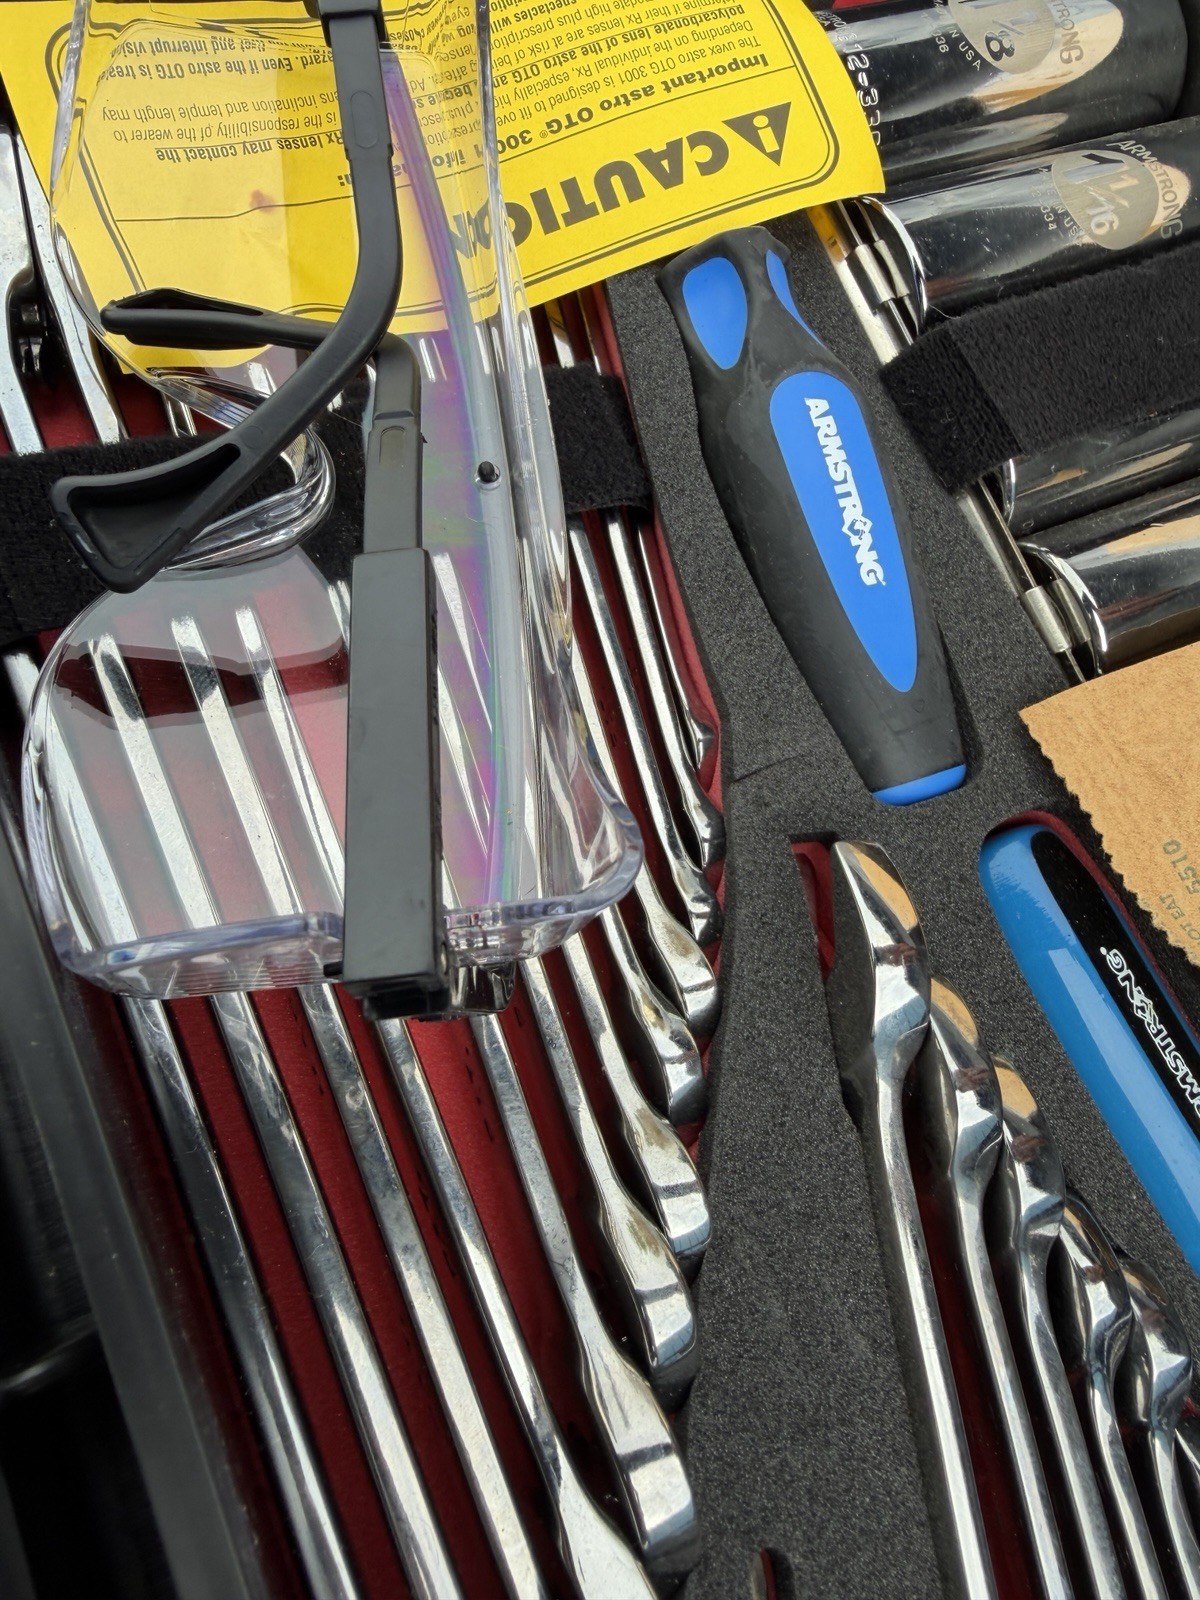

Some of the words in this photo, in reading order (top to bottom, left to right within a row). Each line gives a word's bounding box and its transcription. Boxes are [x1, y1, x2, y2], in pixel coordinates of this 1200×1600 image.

[584, 2, 611, 19] high
[645, 5, 671, 20] their
[672, 3, 682, 14] if
[556, 8, 582, 26] plus
[625, 12, 642, 24] Rx
[653, 3, 745, 34] polycarbonate
[586, 17, 625, 35] lenses
[690, 19, 753, 41] Depending
[551, 35, 563, 48] at
[565, 28, 584, 42] are
[621, 27, 651, 43] lens
[673, 34, 689, 46] on
[737, 35, 761, 47] The
[148, 37, 208, 56] interrupt
[527, 40, 549, 57] risk
[580, 42, 602, 56] the
[605, 36, 618, 51] of
[653, 39, 672, 52] the
[708, 40, 736, 55] uvex
[295, 52, 333, 69] azard.
[513, 48, 525, 64] of
[541, 49, 577, 69] astro
[593, 45, 651, 73] individual
[677, 48, 706, 63] astro
[959, 41, 981, 71] USA
[138, 64, 152, 79] is
[154, 63, 184, 79] OTG
[187, 61, 221, 76] astro
[224, 60, 246, 75] the
[248, 59, 259, 74] if
[261, 57, 293, 71] Even
[571, 63, 592, 77] Rx,
[649, 57, 676, 74] OTG
[509, 63, 540, 83] OTG
[602, 75, 615, 87] is
[617, 65, 647, 84] 3001
[660, 53, 768, 93] Important
[513, 71, 572, 100] especially
[251, 94, 317, 112] inclination
[319, 89, 339, 104] ens
[548, 80, 600, 110] designed
[599, 84, 655, 111] astro
[102, 106, 130, 120] may
[133, 104, 176, 123] length
[177, 103, 223, 121] temple
[224, 101, 249, 117] and
[518, 105, 532, 120] fit
[533, 100, 547, 112] to
[303, 114, 322, 128] the
[325, 111, 336, 125] is
[130, 128, 173, 140] wearer
[176, 127, 196, 142] the
[200, 126, 212, 141] of
[216, 116, 299, 138] responsibility
[113, 129, 128, 143] to
[276, 134, 323, 149] lenses
[325, 132, 342, 144] Rx
[183, 144, 237, 162] contact
[240, 137, 272, 155] may
[155, 147, 181, 163] the
[1106, 139, 1184, 240] ARMSTRONG
[1158, 893, 1186, 920] EAT
[1180, 921, 1200, 941] OT
